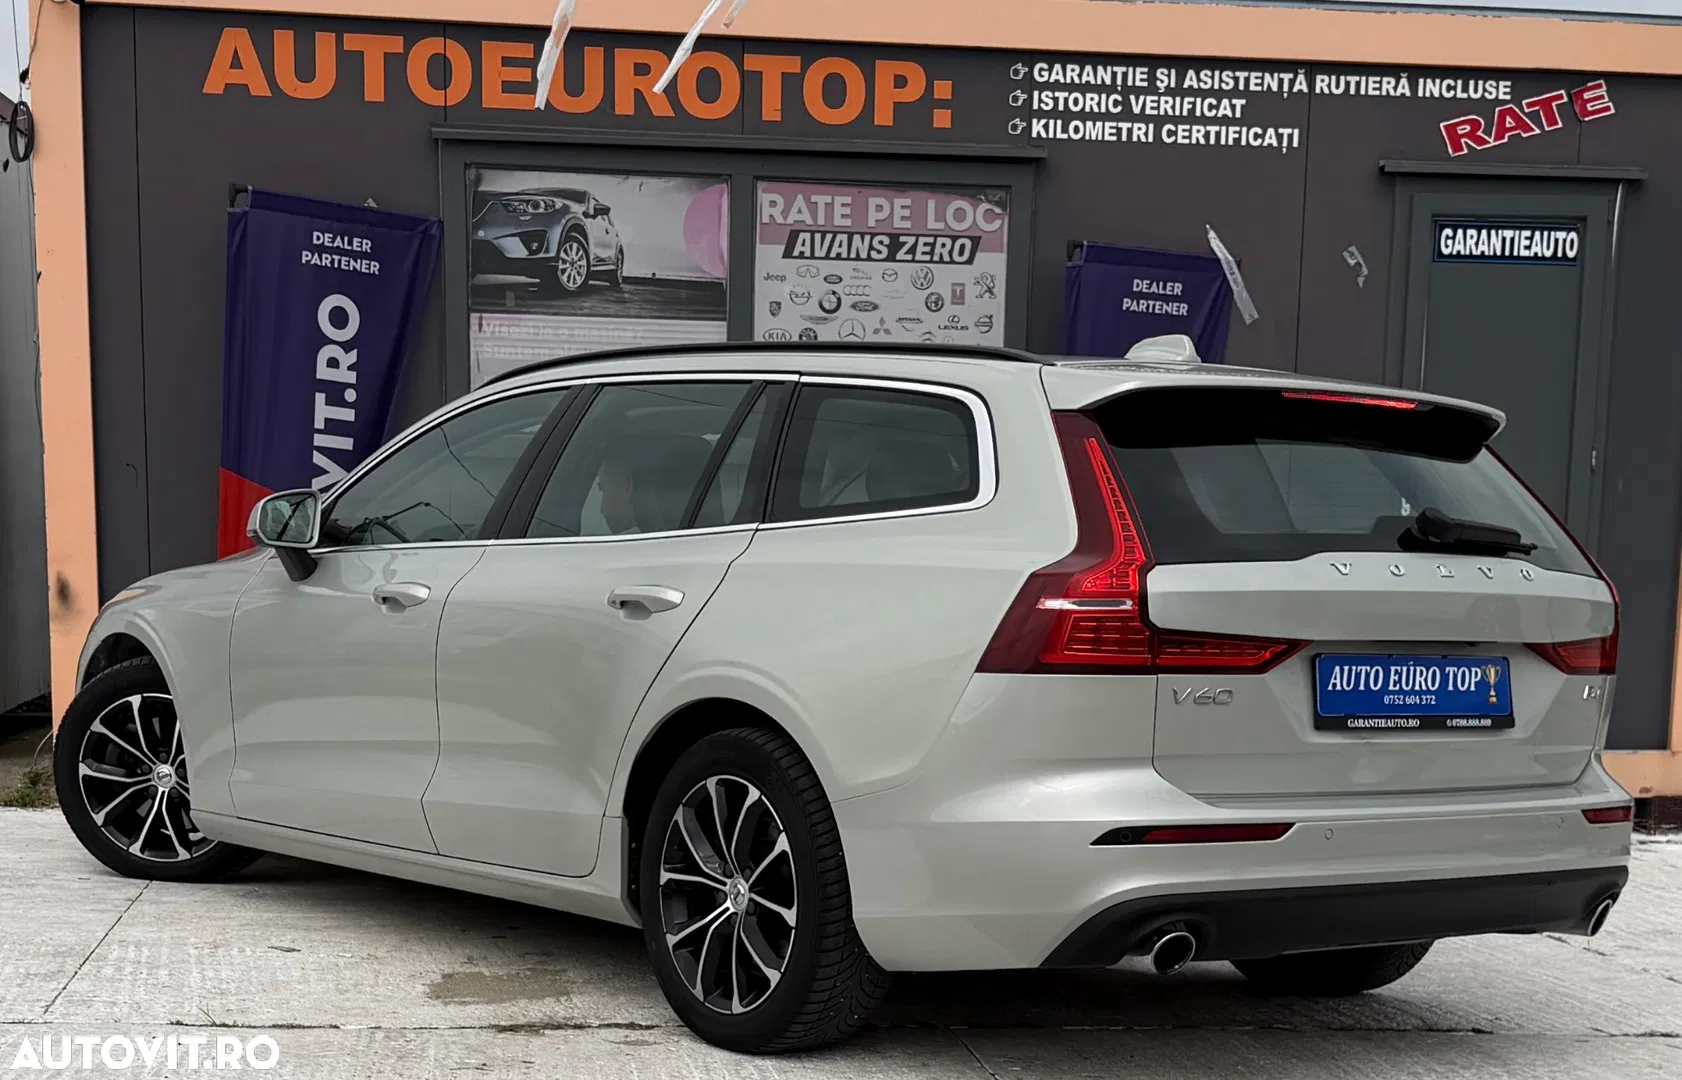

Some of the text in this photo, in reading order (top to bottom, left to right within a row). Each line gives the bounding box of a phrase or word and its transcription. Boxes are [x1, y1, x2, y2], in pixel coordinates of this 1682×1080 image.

[203, 27, 953, 129] AUTOEUROTOP:
[1315, 74, 1411, 97] RUTIERĂ
[1417, 78, 1512, 100] INCLUSE
[1032, 90, 1247, 118] ISTORIC VERIFICAT
[1031, 118, 1154, 143] KILOMETRI
[1440, 80, 1616, 157] RATE
[761, 193, 1003, 232] RATE PE LOC
[312, 231, 372, 252] DEALER
[792, 232, 972, 263] AVANS ZERO
[1440, 228, 1579, 259] GARANTIEAUTO
[301, 250, 380, 275] PARTENER
[763, 272, 787, 283] Jeep
[1133, 279, 1182, 296] DEALER
[1122, 298, 1188, 316] PARTENER
[1329, 562, 1536, 582] VOLVO
[1327, 665, 1384, 691] AUTO
[1446, 666, 1482, 691] TOP
[1172, 687, 1233, 705] V60
[1384, 695, 1436, 705] 0752 604 372
[1347, 718, 1420, 728] GARANTIEAUTO.RO
